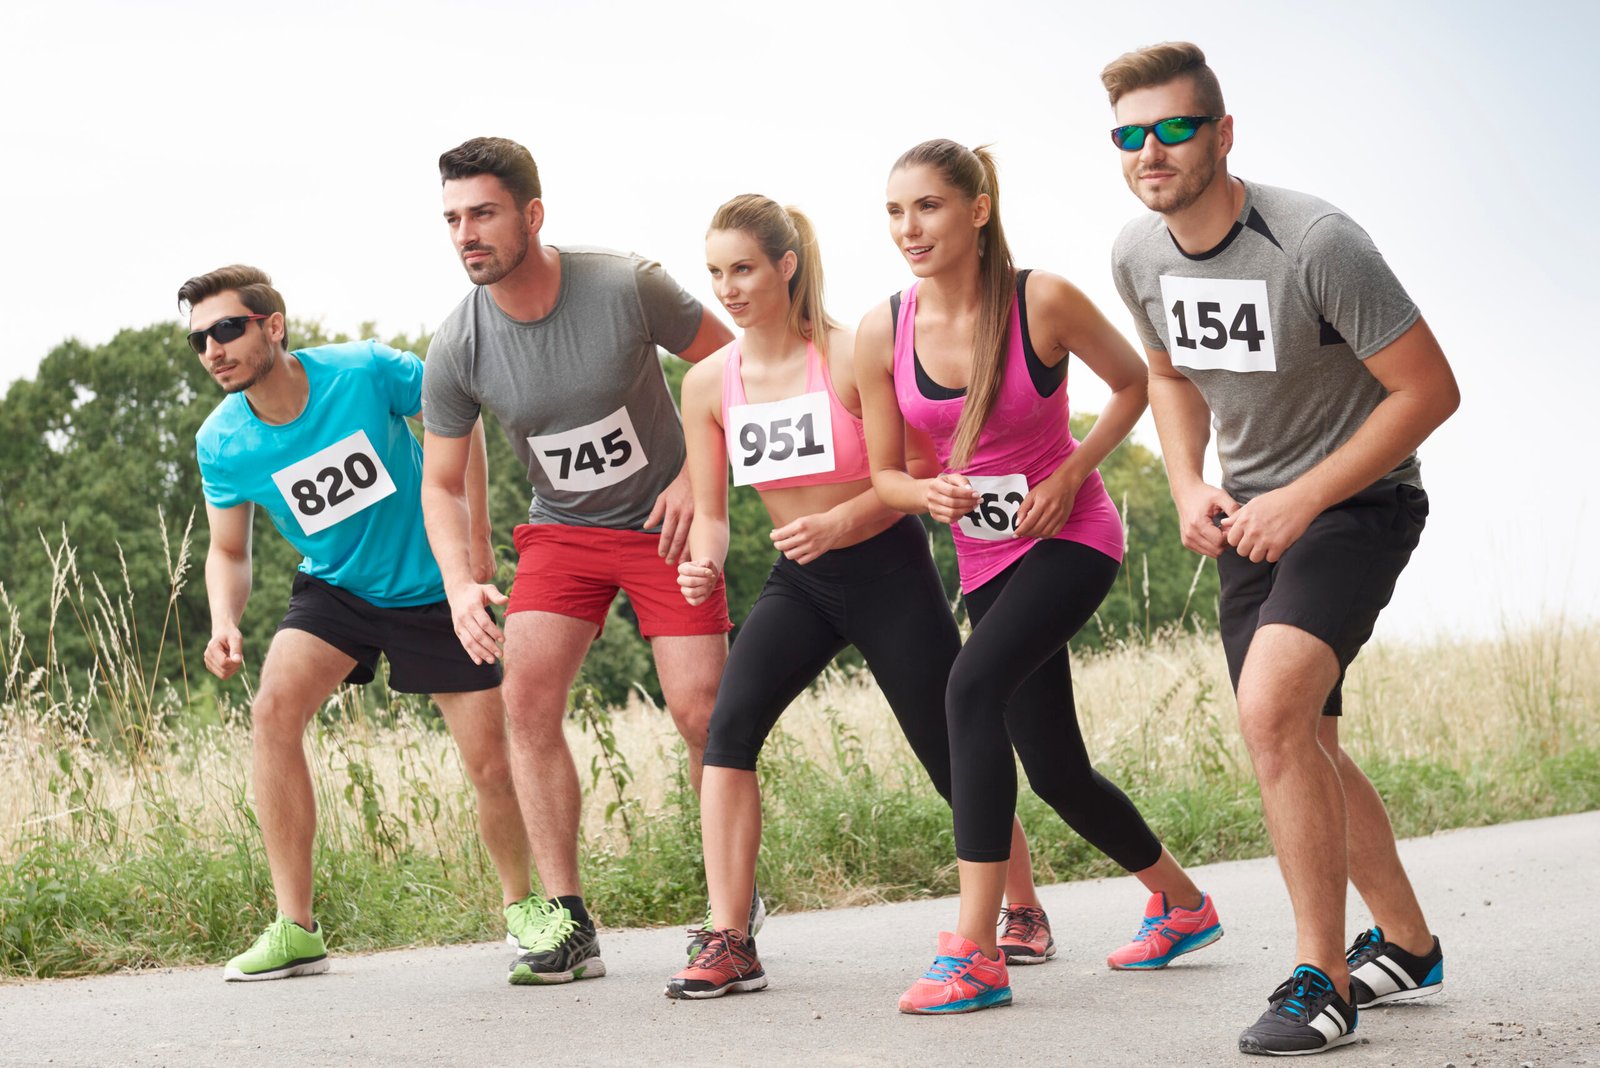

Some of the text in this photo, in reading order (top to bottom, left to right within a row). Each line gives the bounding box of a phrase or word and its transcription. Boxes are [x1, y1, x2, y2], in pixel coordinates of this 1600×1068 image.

[1171, 299, 1265, 352] 154
[544, 427, 632, 480] 745
[739, 413, 825, 467] 951
[291, 452, 378, 516] 820
